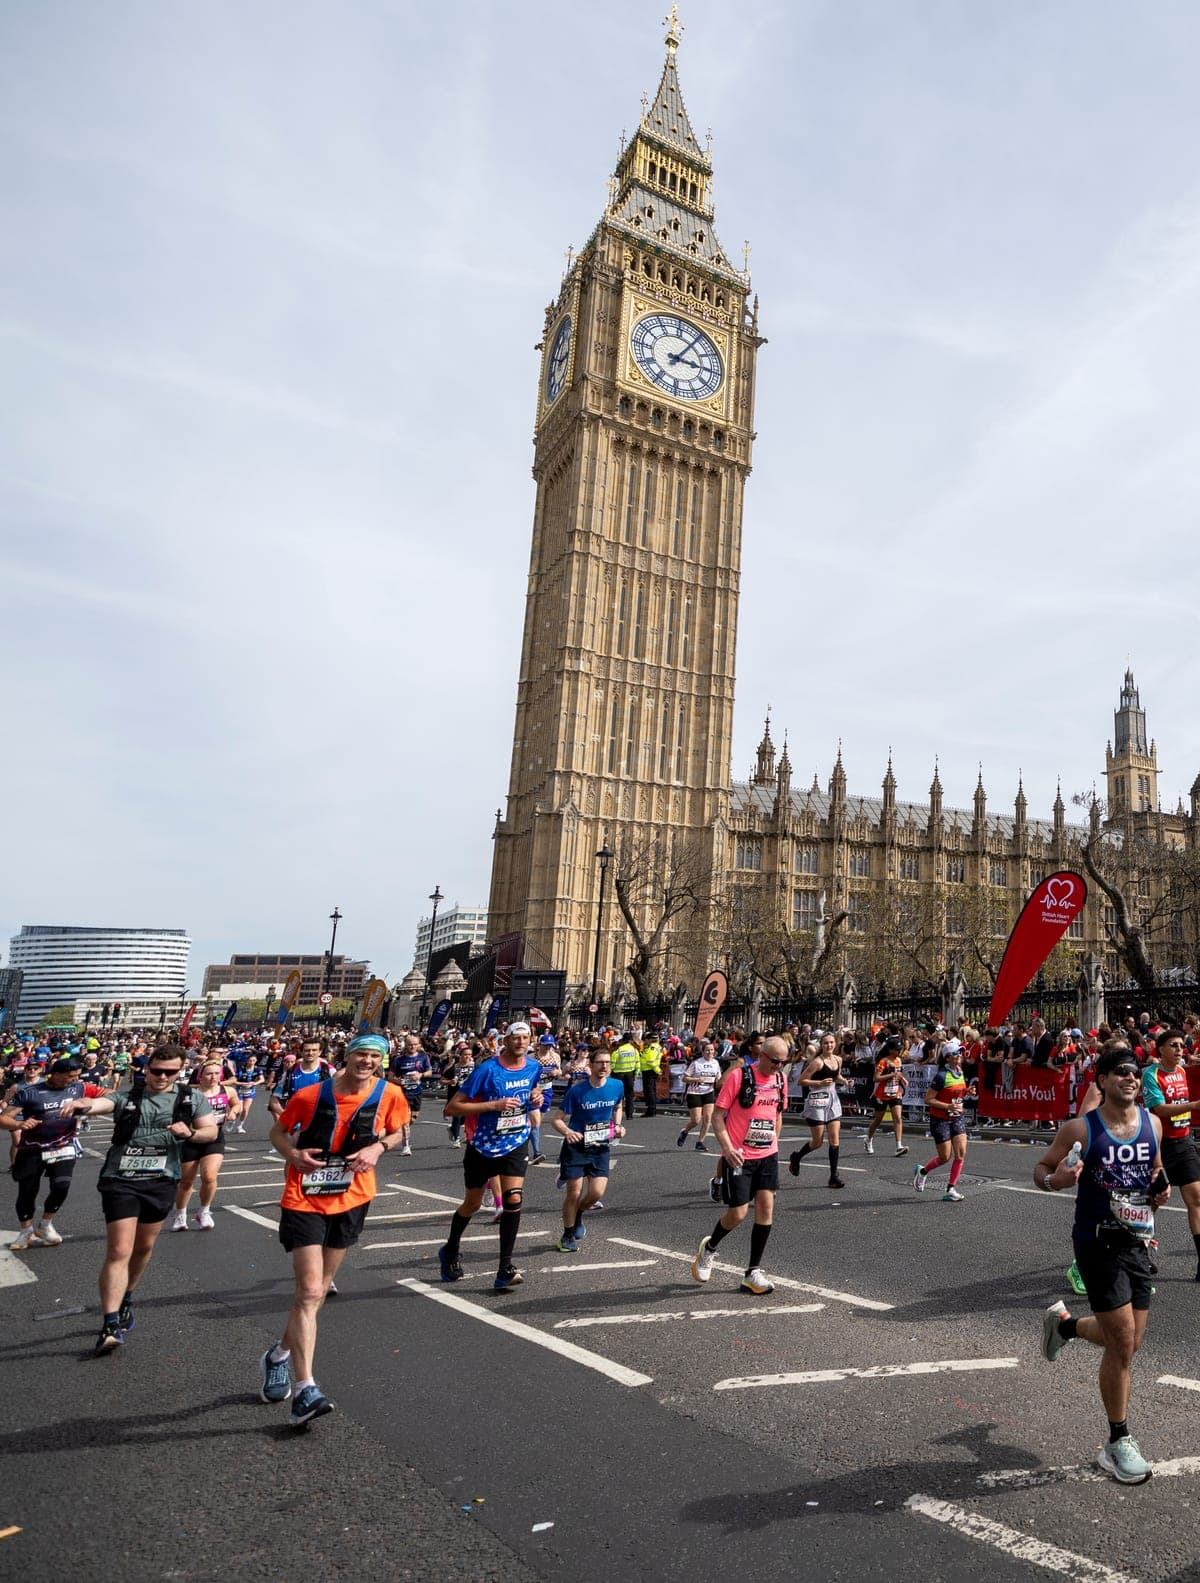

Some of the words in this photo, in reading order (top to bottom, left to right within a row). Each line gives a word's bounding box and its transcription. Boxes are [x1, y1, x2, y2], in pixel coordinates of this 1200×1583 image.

[505, 1079, 530, 1090] JAMES
[1029, 1085, 1056, 1101] You!
[1102, 1142, 1150, 1165] JOE
[127, 1159, 159, 1169] 75182
[1121, 1163, 1149, 1173] CANCER
[311, 1170, 346, 1182] 63627
[1118, 1207, 1149, 1222] 19941
